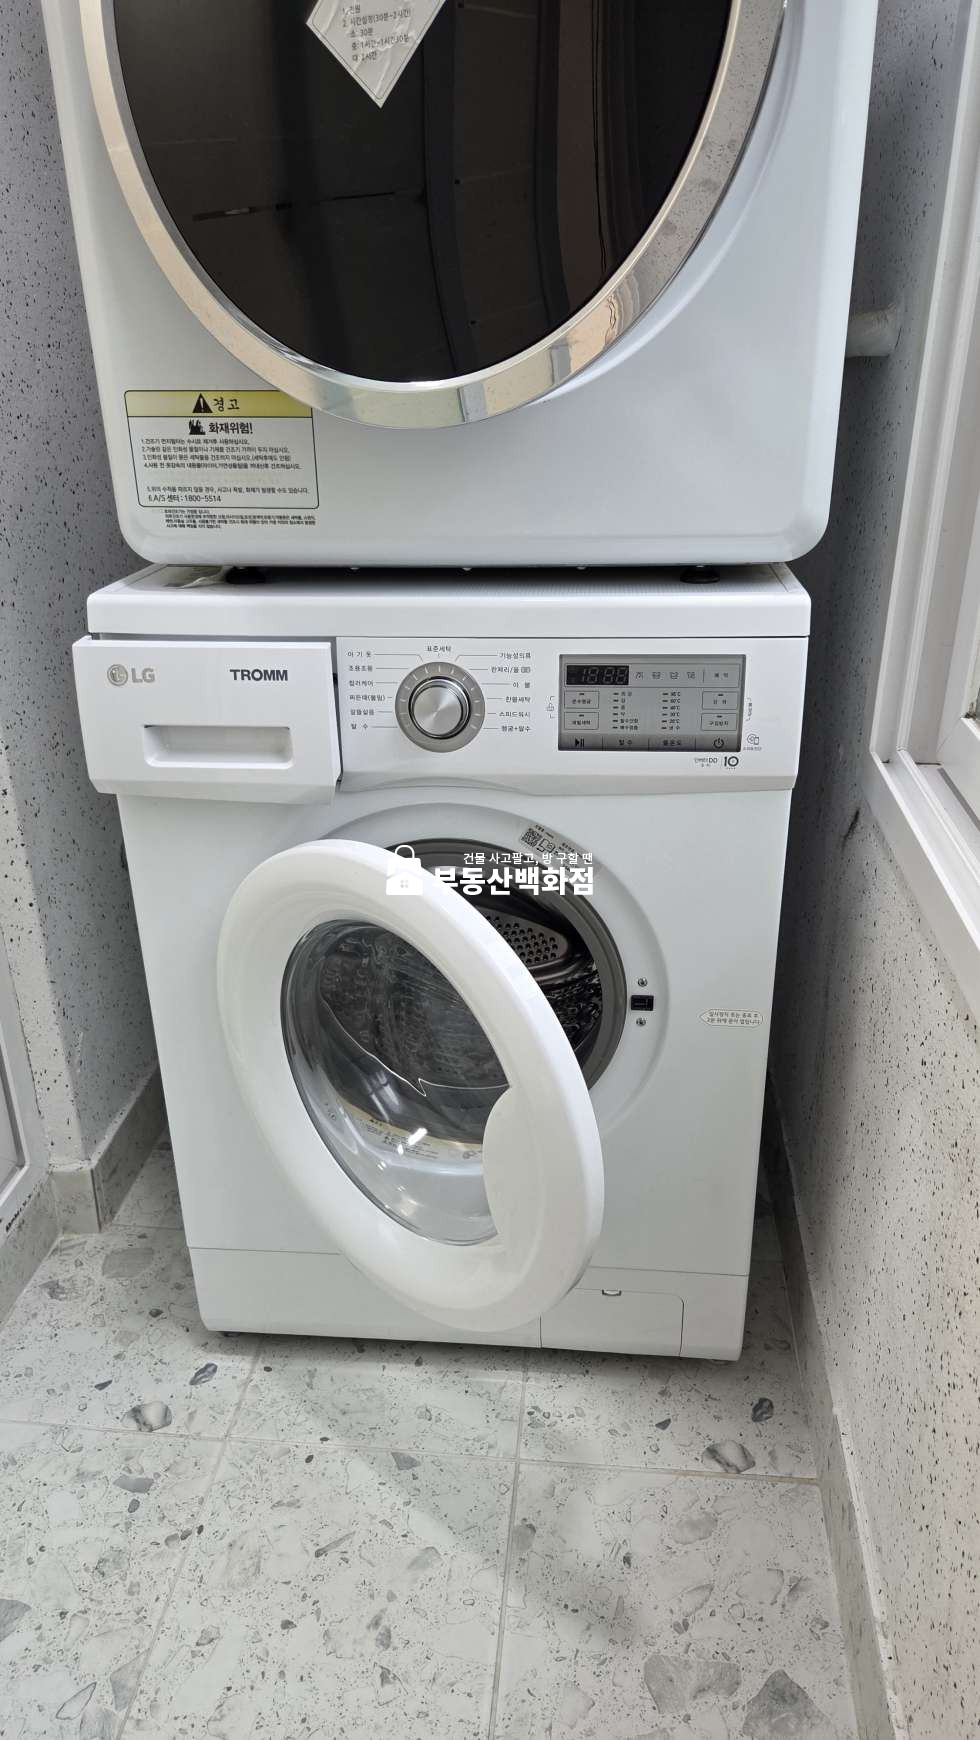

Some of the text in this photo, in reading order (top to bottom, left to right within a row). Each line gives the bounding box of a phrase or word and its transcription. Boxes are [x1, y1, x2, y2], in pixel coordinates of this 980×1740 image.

[208, 422, 254, 434] 화재위험!
[132, 668, 155, 683] LG
[230, 669, 288, 681] TROMM
